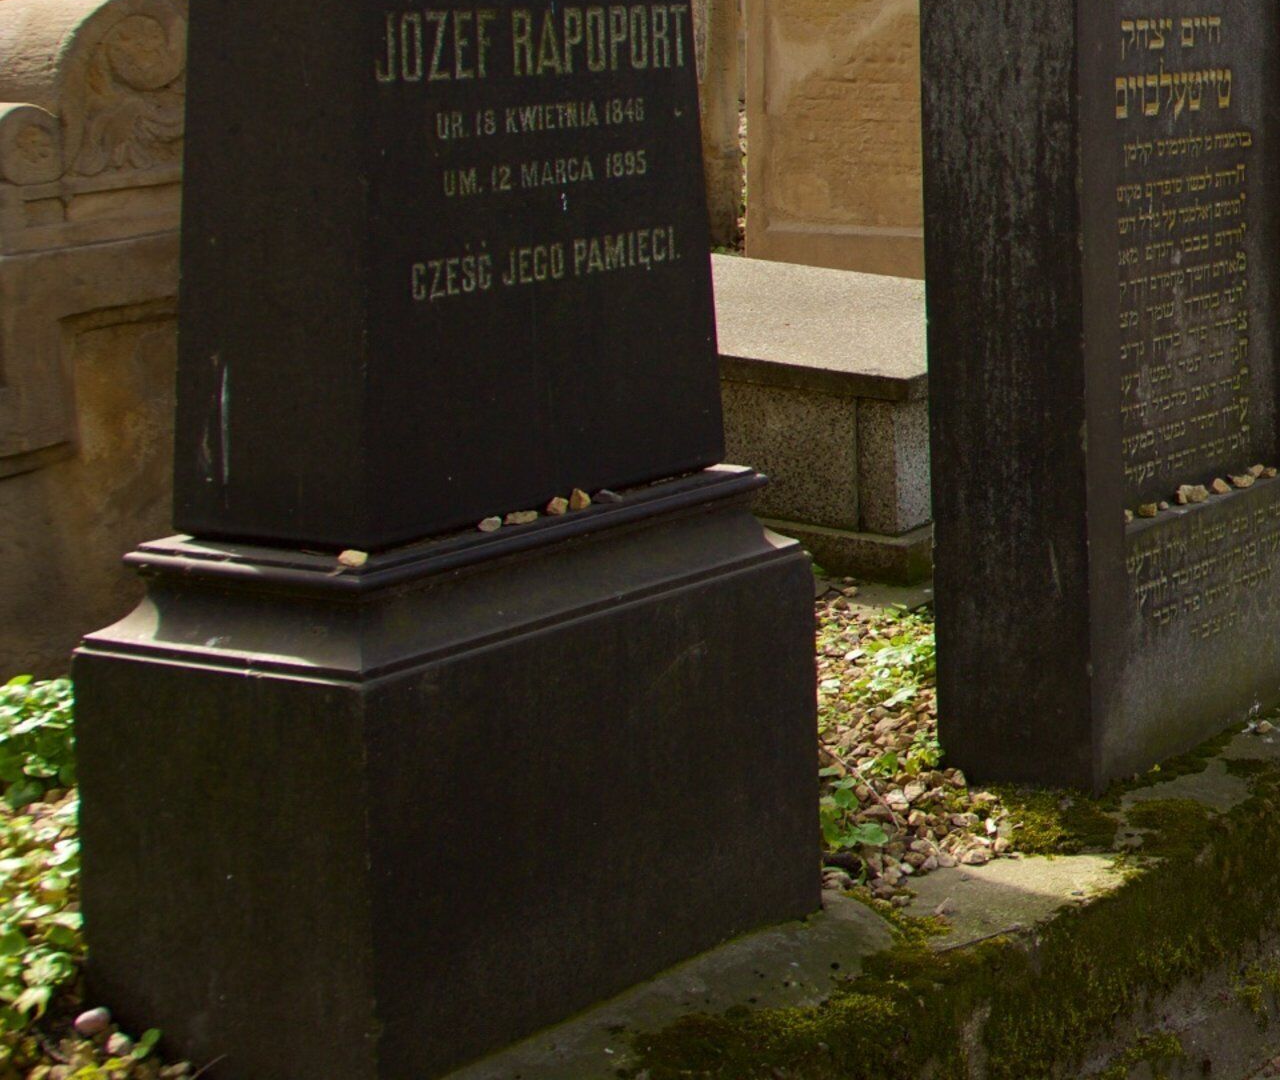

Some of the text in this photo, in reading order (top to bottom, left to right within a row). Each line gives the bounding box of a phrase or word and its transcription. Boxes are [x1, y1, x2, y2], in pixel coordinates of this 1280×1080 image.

[511, 4, 688, 77] RAPOPORT
[1121, 16, 1221, 63] חיים יצחק
[476, 108, 496, 136] 18
[506, 101, 599, 133] KWIETNIA
[442, 149, 647, 197] UM. 12 MARCA 1895
[411, 241, 491, 302] CZEŚĆ
[503, 246, 565, 286] JEGO
